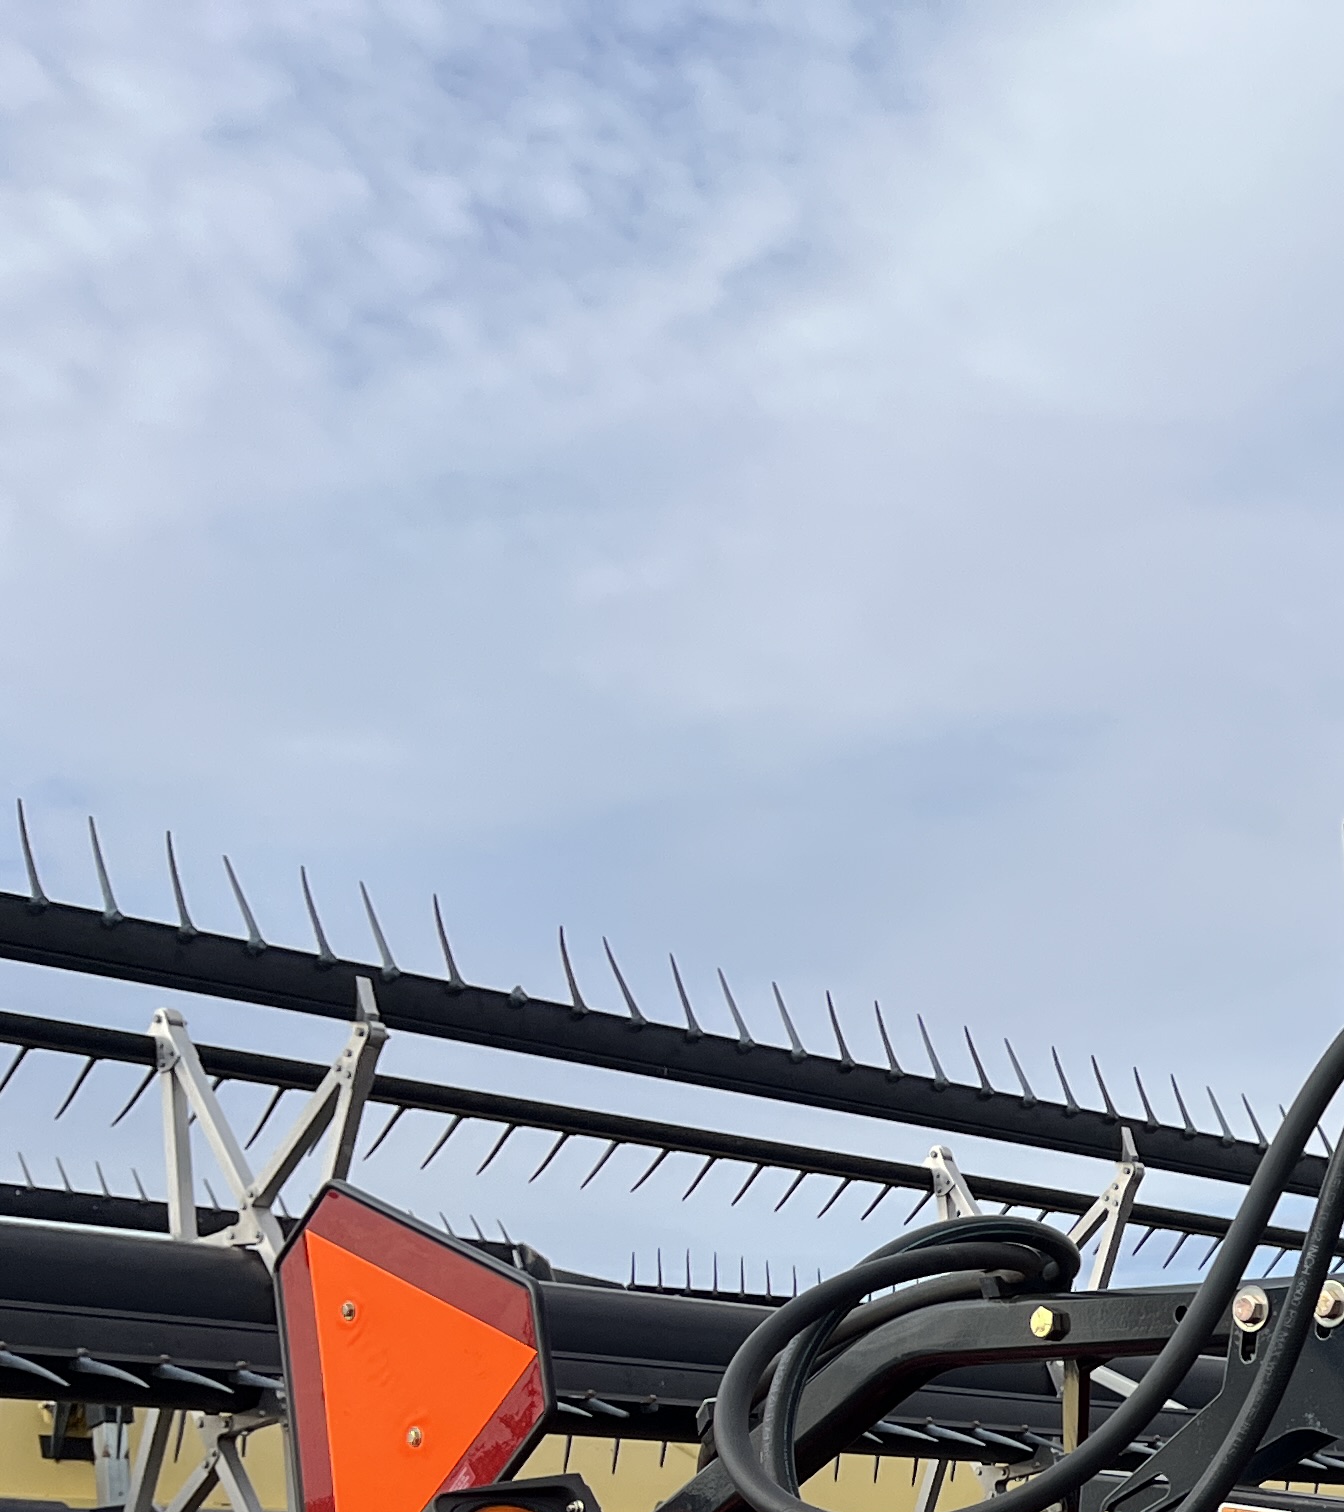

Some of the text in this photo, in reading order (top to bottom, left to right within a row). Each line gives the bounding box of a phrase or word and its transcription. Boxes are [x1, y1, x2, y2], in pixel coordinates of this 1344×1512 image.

[1302, 1244, 1319, 1275] INCH
[1283, 1308, 1297, 1329] PSI
[1271, 1331, 1288, 1358] MAX
